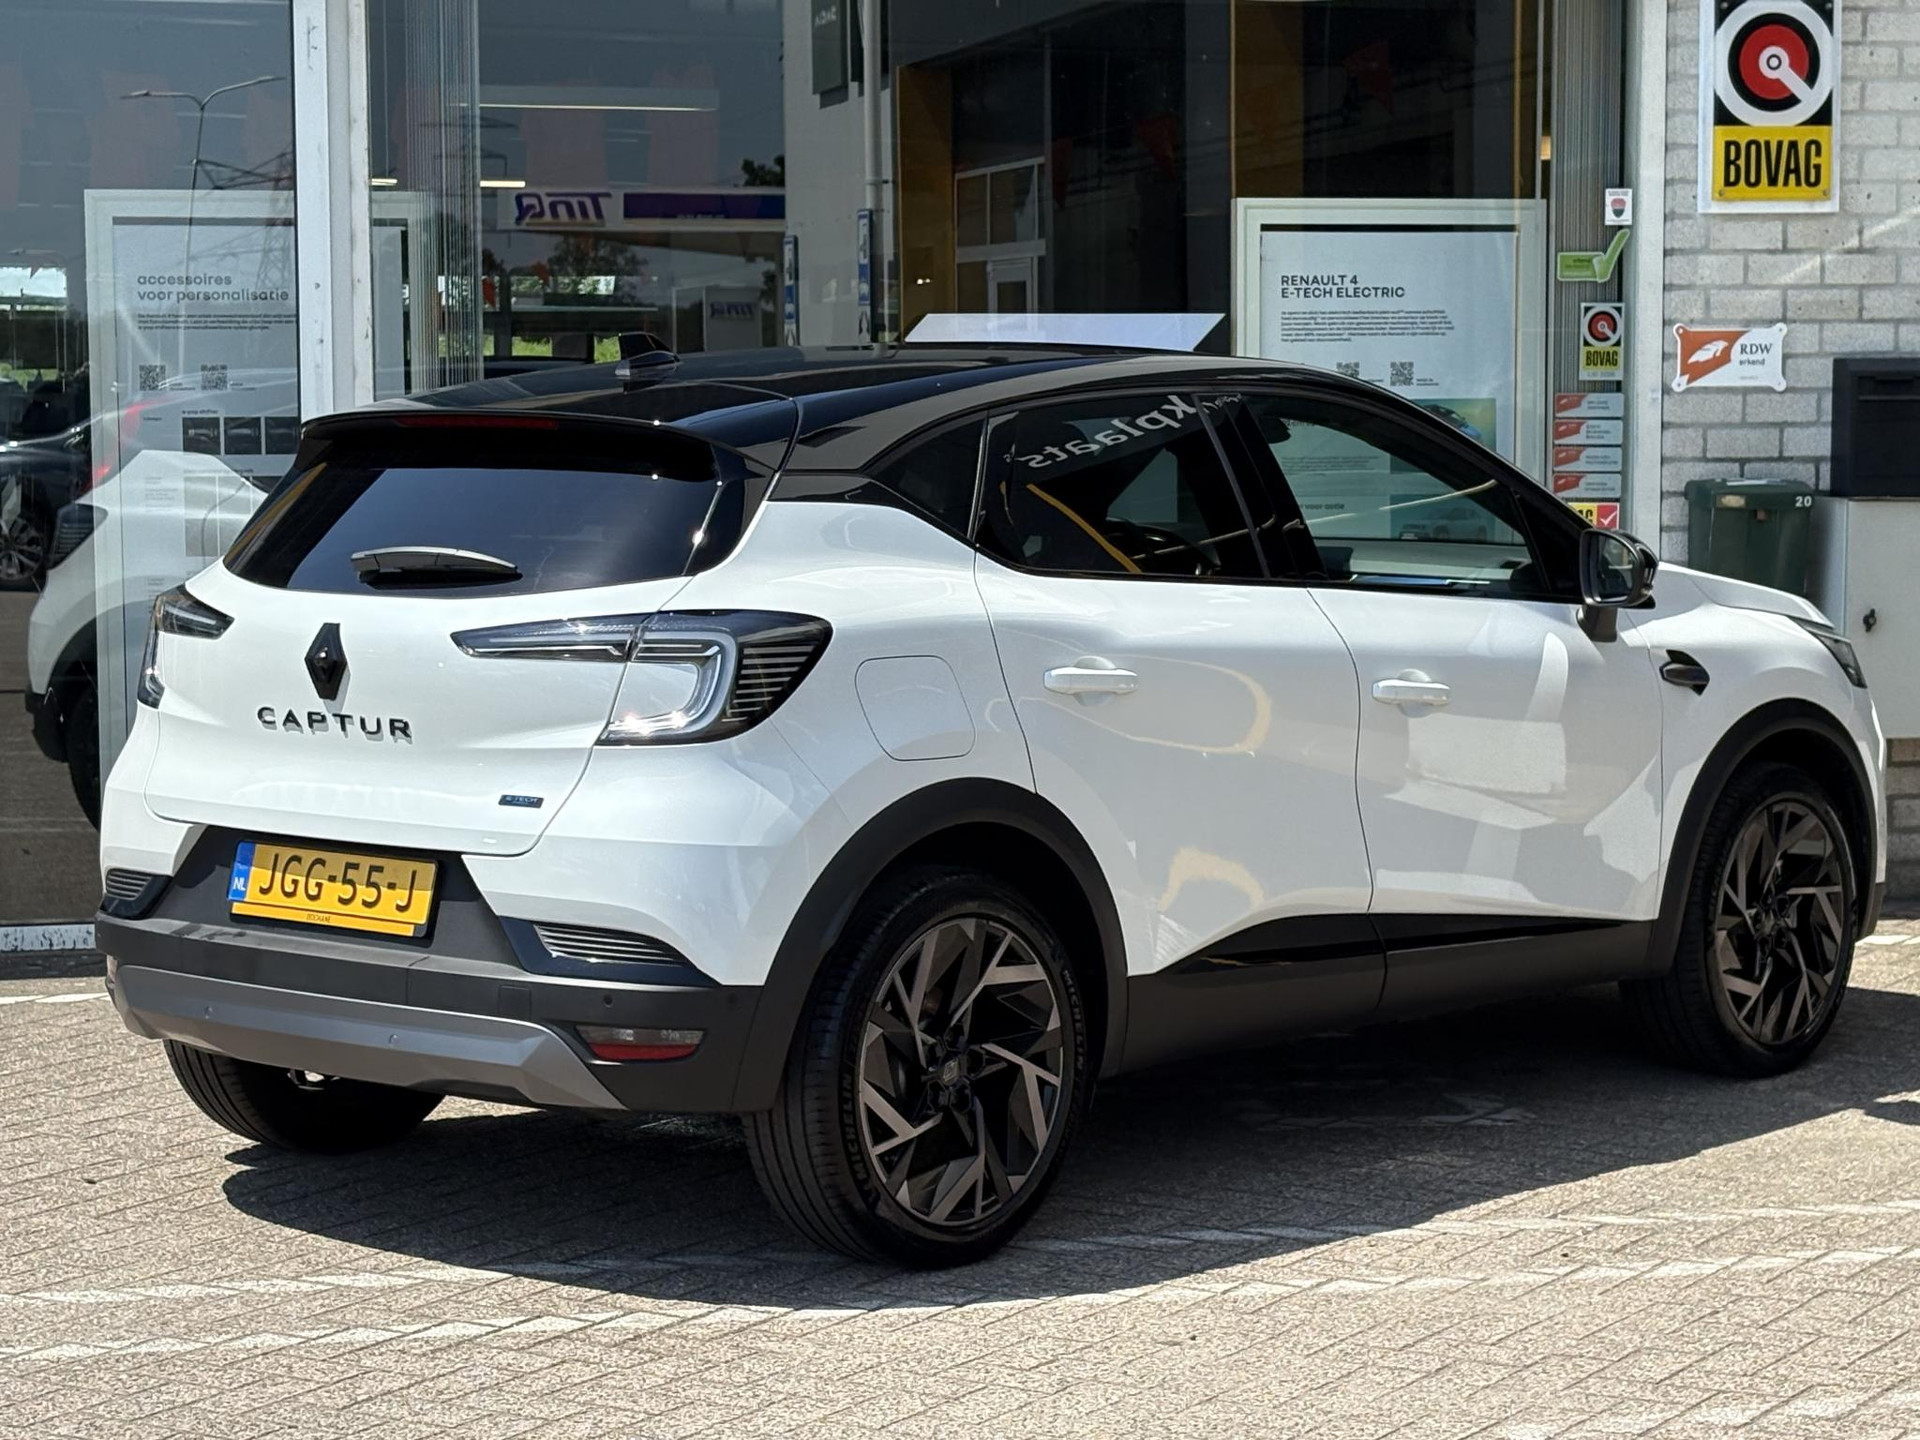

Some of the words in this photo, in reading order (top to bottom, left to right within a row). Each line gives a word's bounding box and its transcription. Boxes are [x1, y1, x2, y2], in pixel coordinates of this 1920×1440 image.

[1723, 138, 1822, 188] BOVAG
[136, 272, 233, 286] accessoires
[1280, 275, 1347, 286] RENAULT
[1349, 275, 1358, 286] 4
[136, 290, 174, 301] voor
[176, 288, 289, 304] personalisatie
[1280, 287, 1333, 298] E-TECH
[1336, 286, 1405, 298] ELECTRIC
[1740, 343, 1773, 355] RDW
[1585, 350, 1618, 367] BOVAG
[1739, 358, 1766, 367] erkend
[1794, 495, 1813, 508] 20
[257, 706, 413, 739] CAPTUR
[232, 876, 247, 891] NL
[258, 852, 418, 913] JGG-55-J
